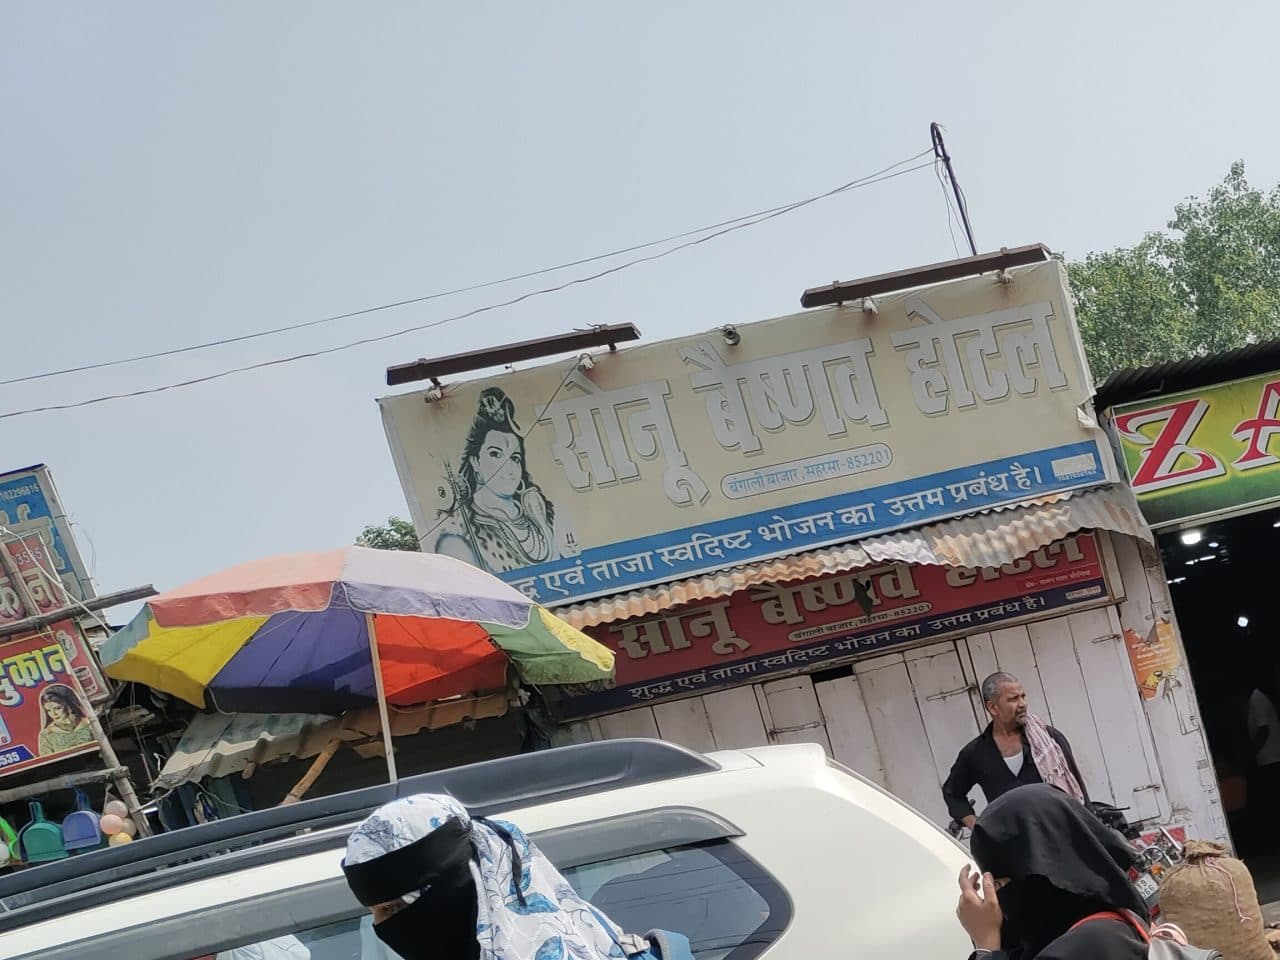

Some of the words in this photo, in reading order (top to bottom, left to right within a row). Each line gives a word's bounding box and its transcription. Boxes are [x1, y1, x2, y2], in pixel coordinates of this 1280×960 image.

[538, 370, 709, 506] सोनू
[892, 300, 1071, 418] होटल
[539, 559, 586, 596] एवं
[586, 551, 653, 582] ताजा
[757, 514, 836, 542] भोजन
[835, 502, 876, 526] का
[884, 487, 945, 516] उत्तम
[945, 470, 1010, 503] प्रबंध
[728, 471, 764, 494] बंगाली
[628, 680, 674, 700] शुद्ध
[675, 669, 708, 689] एवं
[711, 661, 757, 680] ताजा
[833, 629, 891, 655] भोजन
[892, 623, 921, 640] का
[927, 612, 973, 634] उत्तम
[974, 599, 1021, 622] प्रबंध
